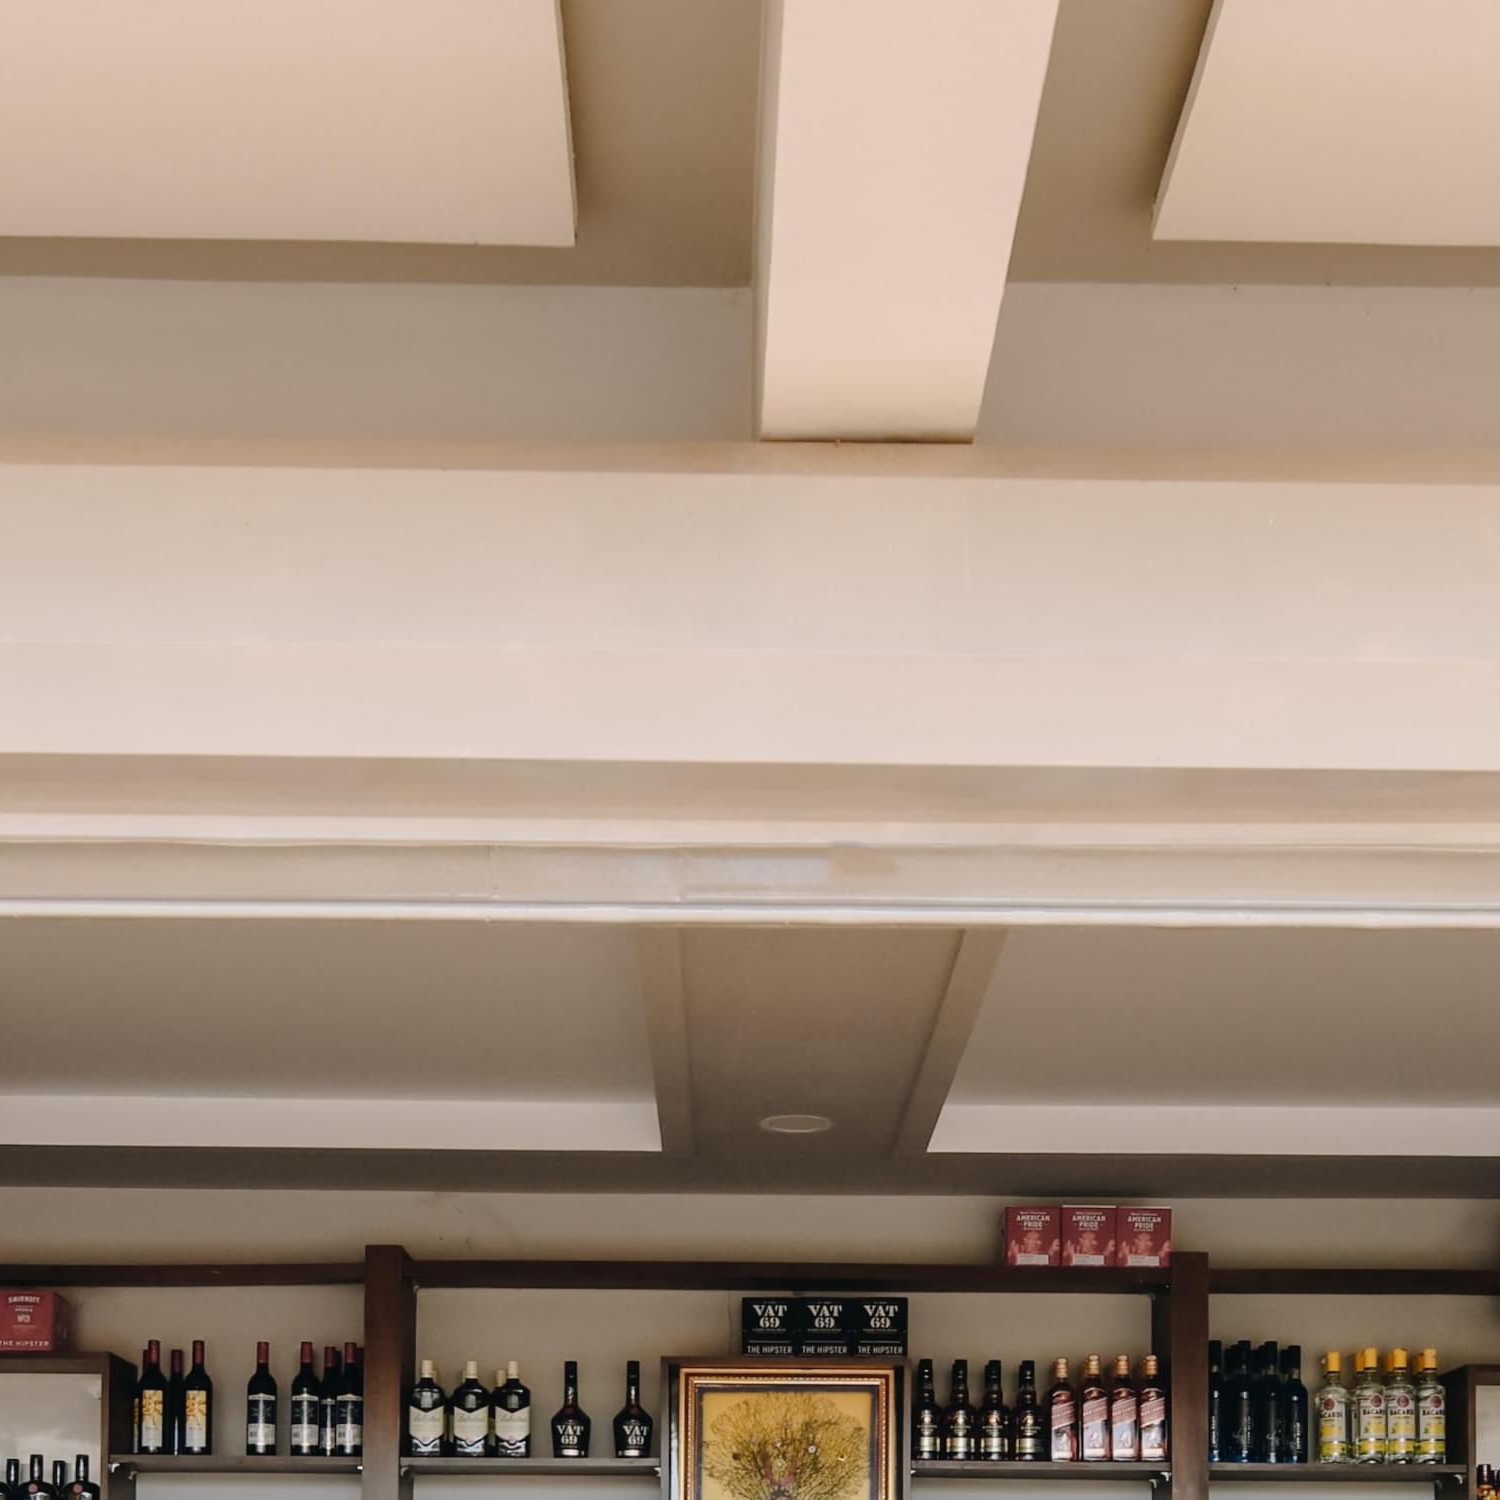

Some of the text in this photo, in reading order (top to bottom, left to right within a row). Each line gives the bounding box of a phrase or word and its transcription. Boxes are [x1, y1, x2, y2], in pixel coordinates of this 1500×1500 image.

[8, 1296, 41, 1304] SMIRNOFF
[752, 1304, 788, 1317] VAT
[807, 1304, 844, 1317] VAT
[863, 1304, 900, 1317] VAT
[758, 1316, 780, 1329] 69
[814, 1316, 836, 1329] 69
[870, 1316, 892, 1329] 69
[747, 1346, 793, 1354] THE HIPSTER
[802, 1346, 848, 1354] THE HIPSTER
[858, 1346, 904, 1354] THE HIPSTER
[556, 1425, 584, 1436] VAT
[622, 1425, 649, 1436] VAT
[561, 1435, 578, 1445] 69
[628, 1436, 644, 1446] 69
